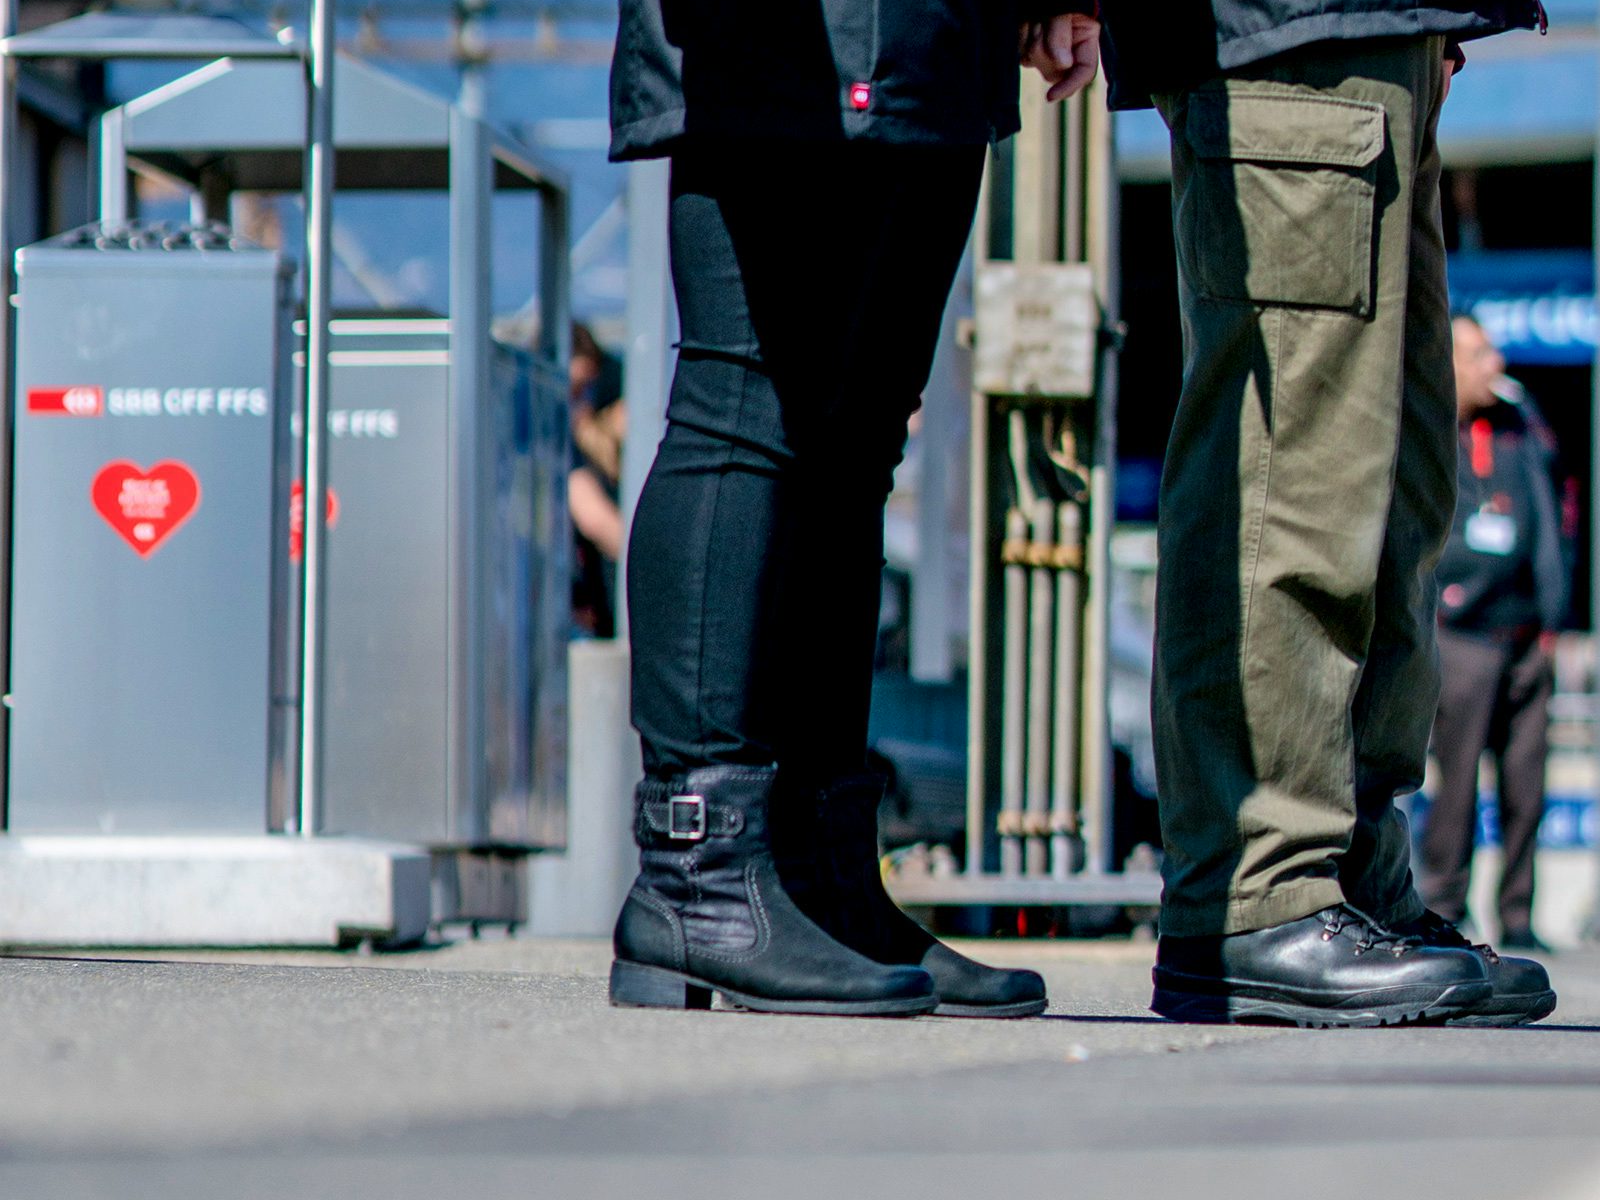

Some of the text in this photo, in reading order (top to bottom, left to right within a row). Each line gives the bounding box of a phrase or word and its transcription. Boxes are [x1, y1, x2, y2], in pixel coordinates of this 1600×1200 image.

[108, 387, 267, 416] SBB CFF FFS
[350, 409, 398, 438] FFS
